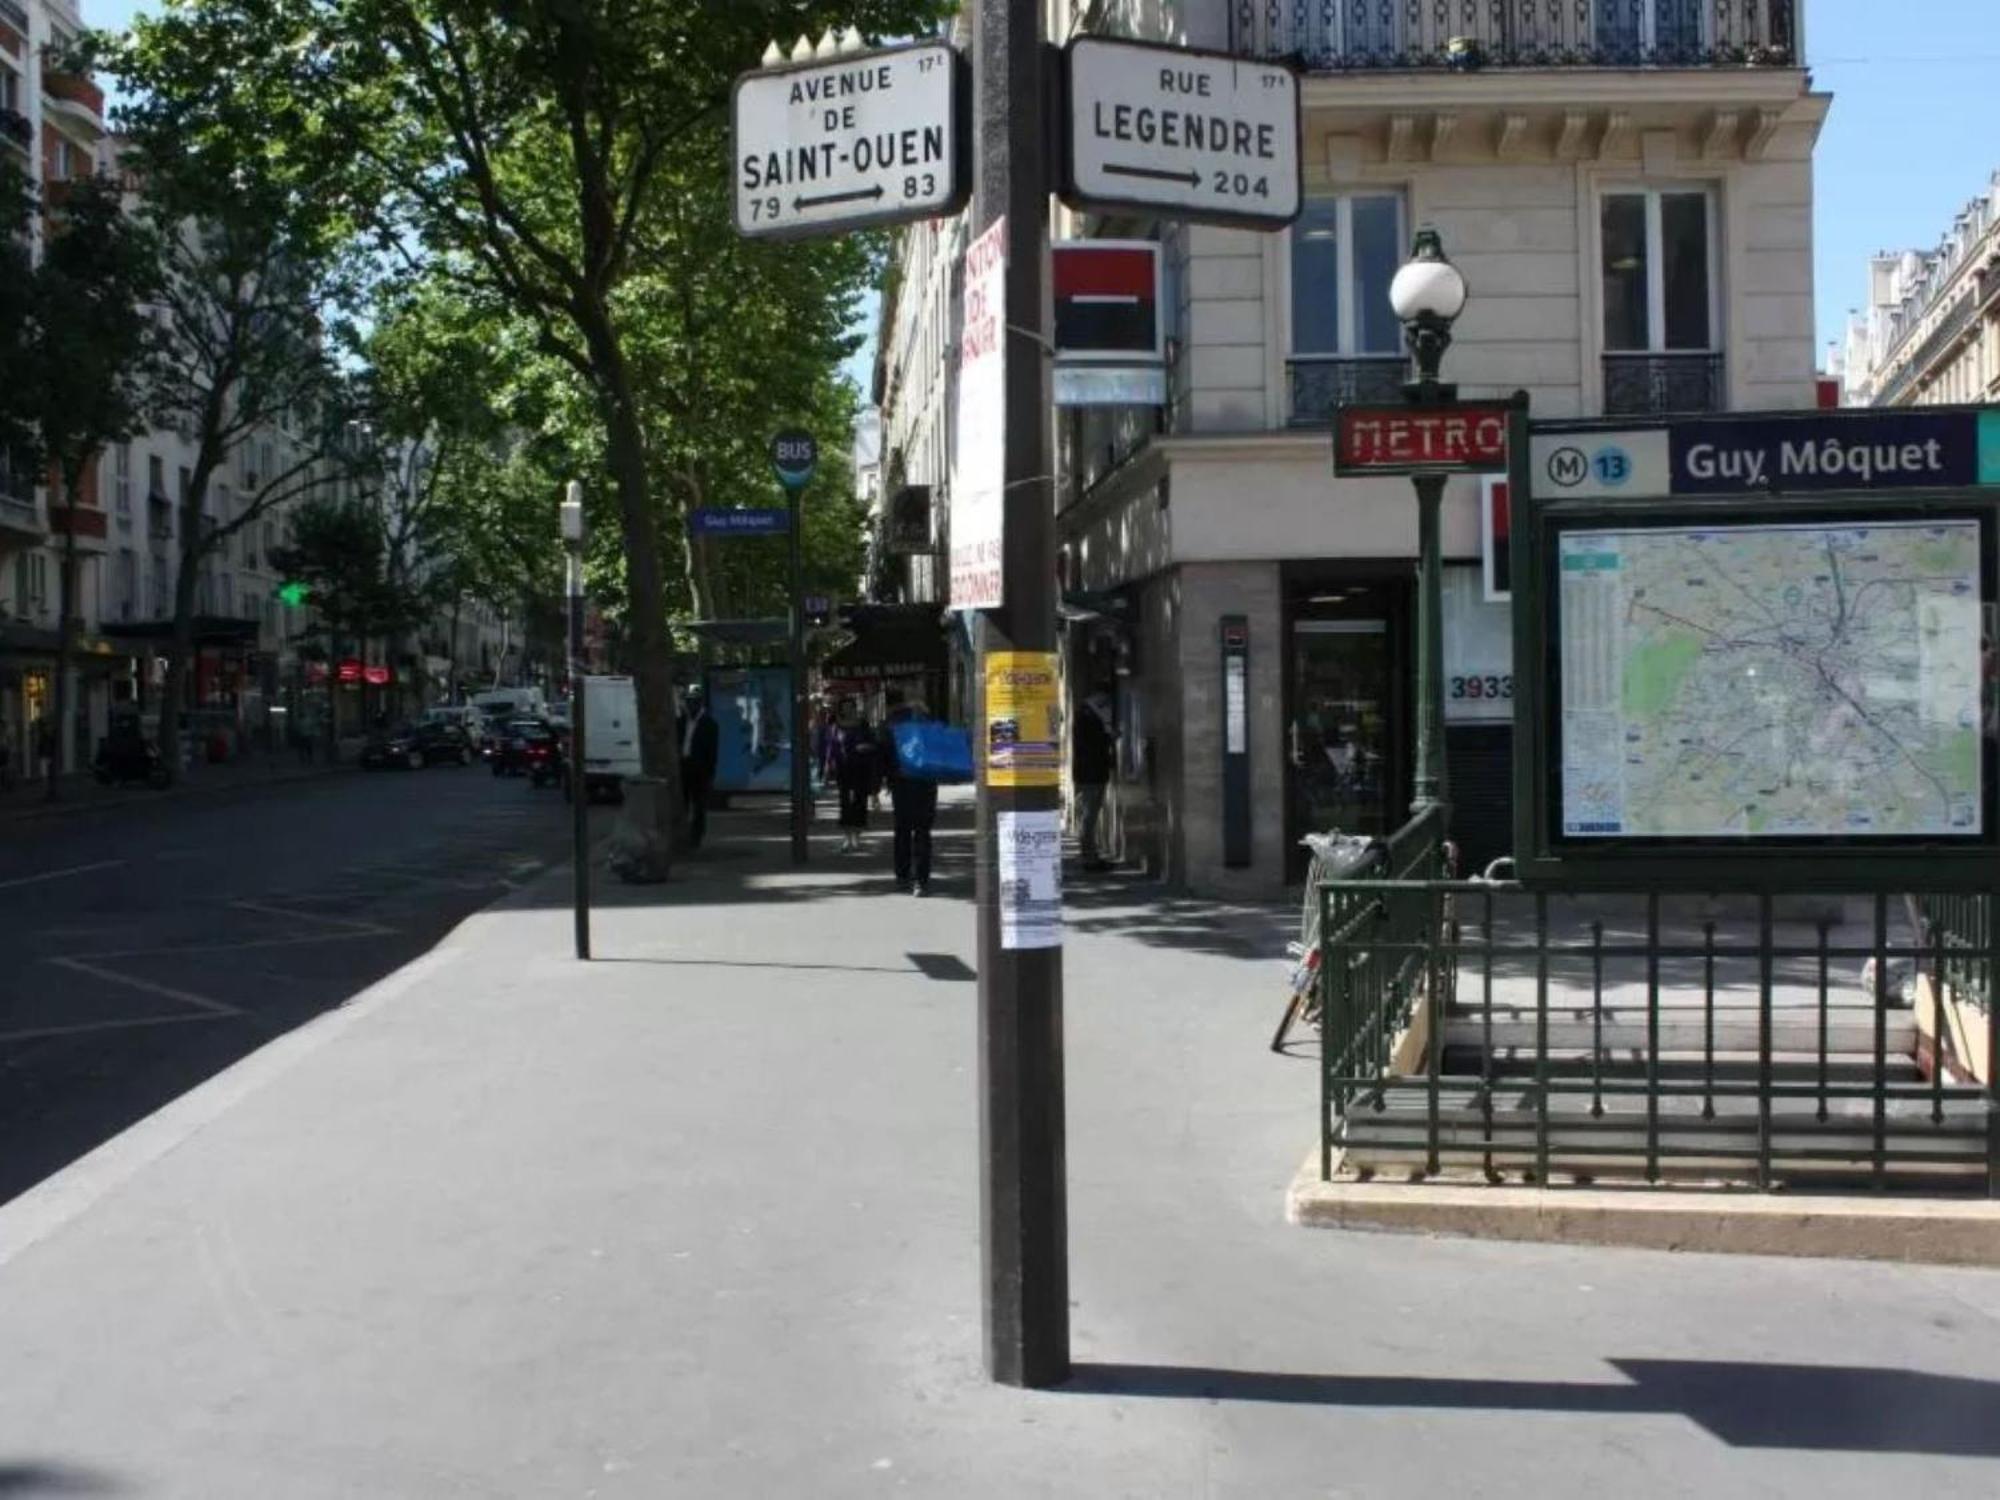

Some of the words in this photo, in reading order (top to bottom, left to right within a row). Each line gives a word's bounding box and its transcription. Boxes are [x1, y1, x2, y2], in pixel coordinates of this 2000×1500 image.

[789, 65, 893, 105] AVENUE
[1159, 68, 1212, 98] RUE
[823, 105, 856, 132] DE
[1094, 100, 1275, 160] LEGENDRE
[743, 124, 943, 190] SAINT-OUEN
[750, 196, 780, 221] 79
[903, 173, 935, 199] 83
[1213, 170, 1270, 198] 204
[776, 441, 812, 460] BUS
[1352, 417, 1504, 457] METRO
[1595, 454, 1627, 479] 13
[1685, 444, 1766, 486] Guy
[1780, 437, 1943, 481] Môquet
[1451, 675, 1513, 699] 3933
